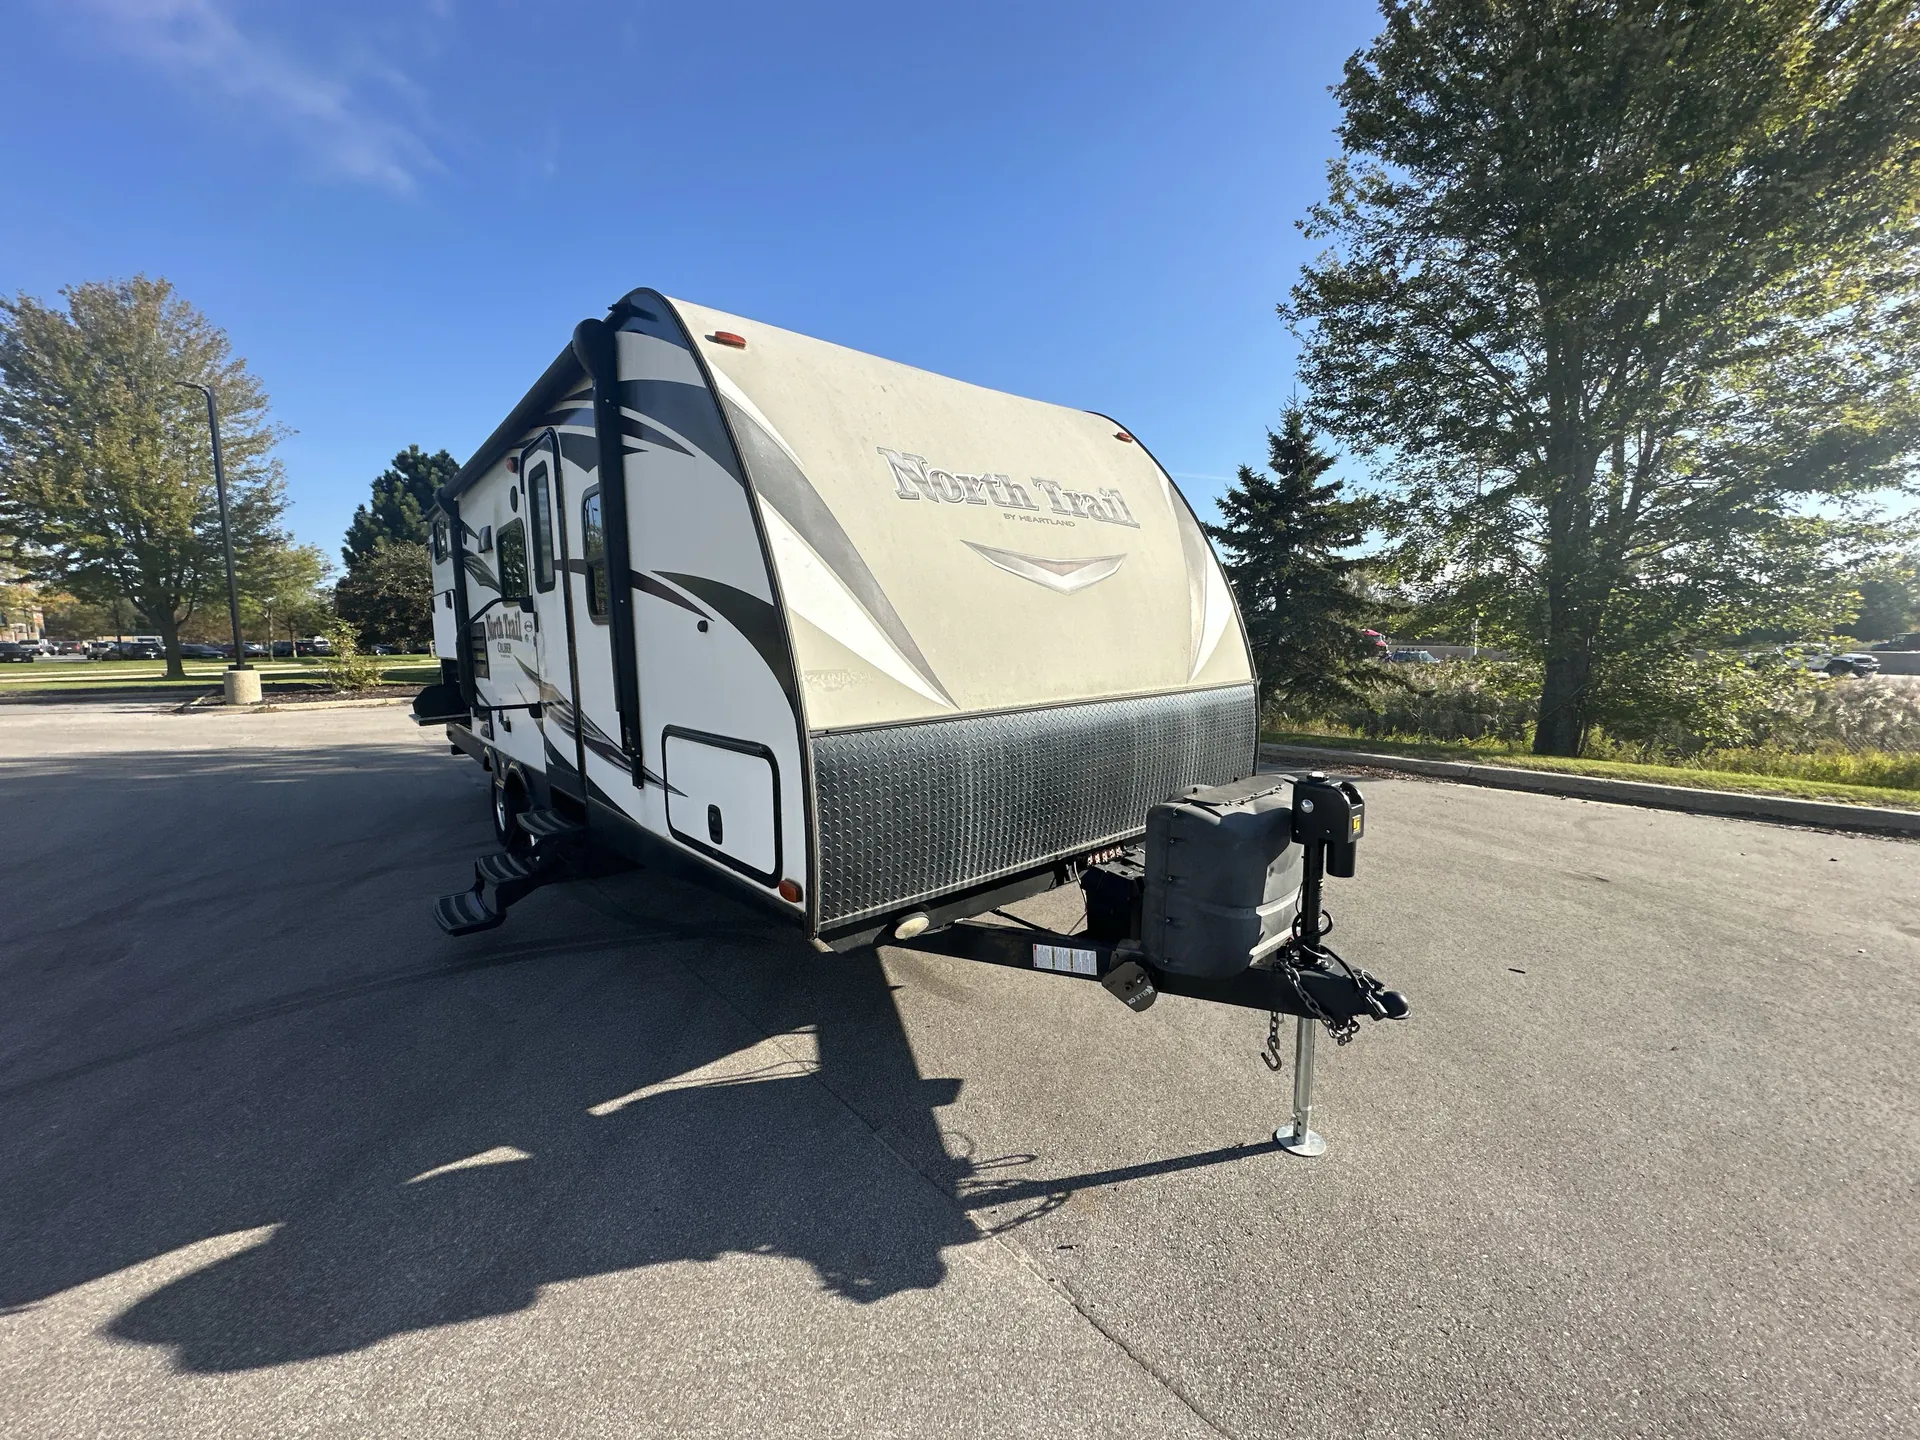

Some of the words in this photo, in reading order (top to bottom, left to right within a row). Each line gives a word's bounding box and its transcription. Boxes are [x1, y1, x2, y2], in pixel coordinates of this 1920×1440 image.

[877, 446, 1039, 511] North
[1030, 476, 1141, 529] Trail
[1019, 515, 1075, 527] HEARTLAND
[485, 613, 504, 641] North
[503, 611, 522, 641] Trail
